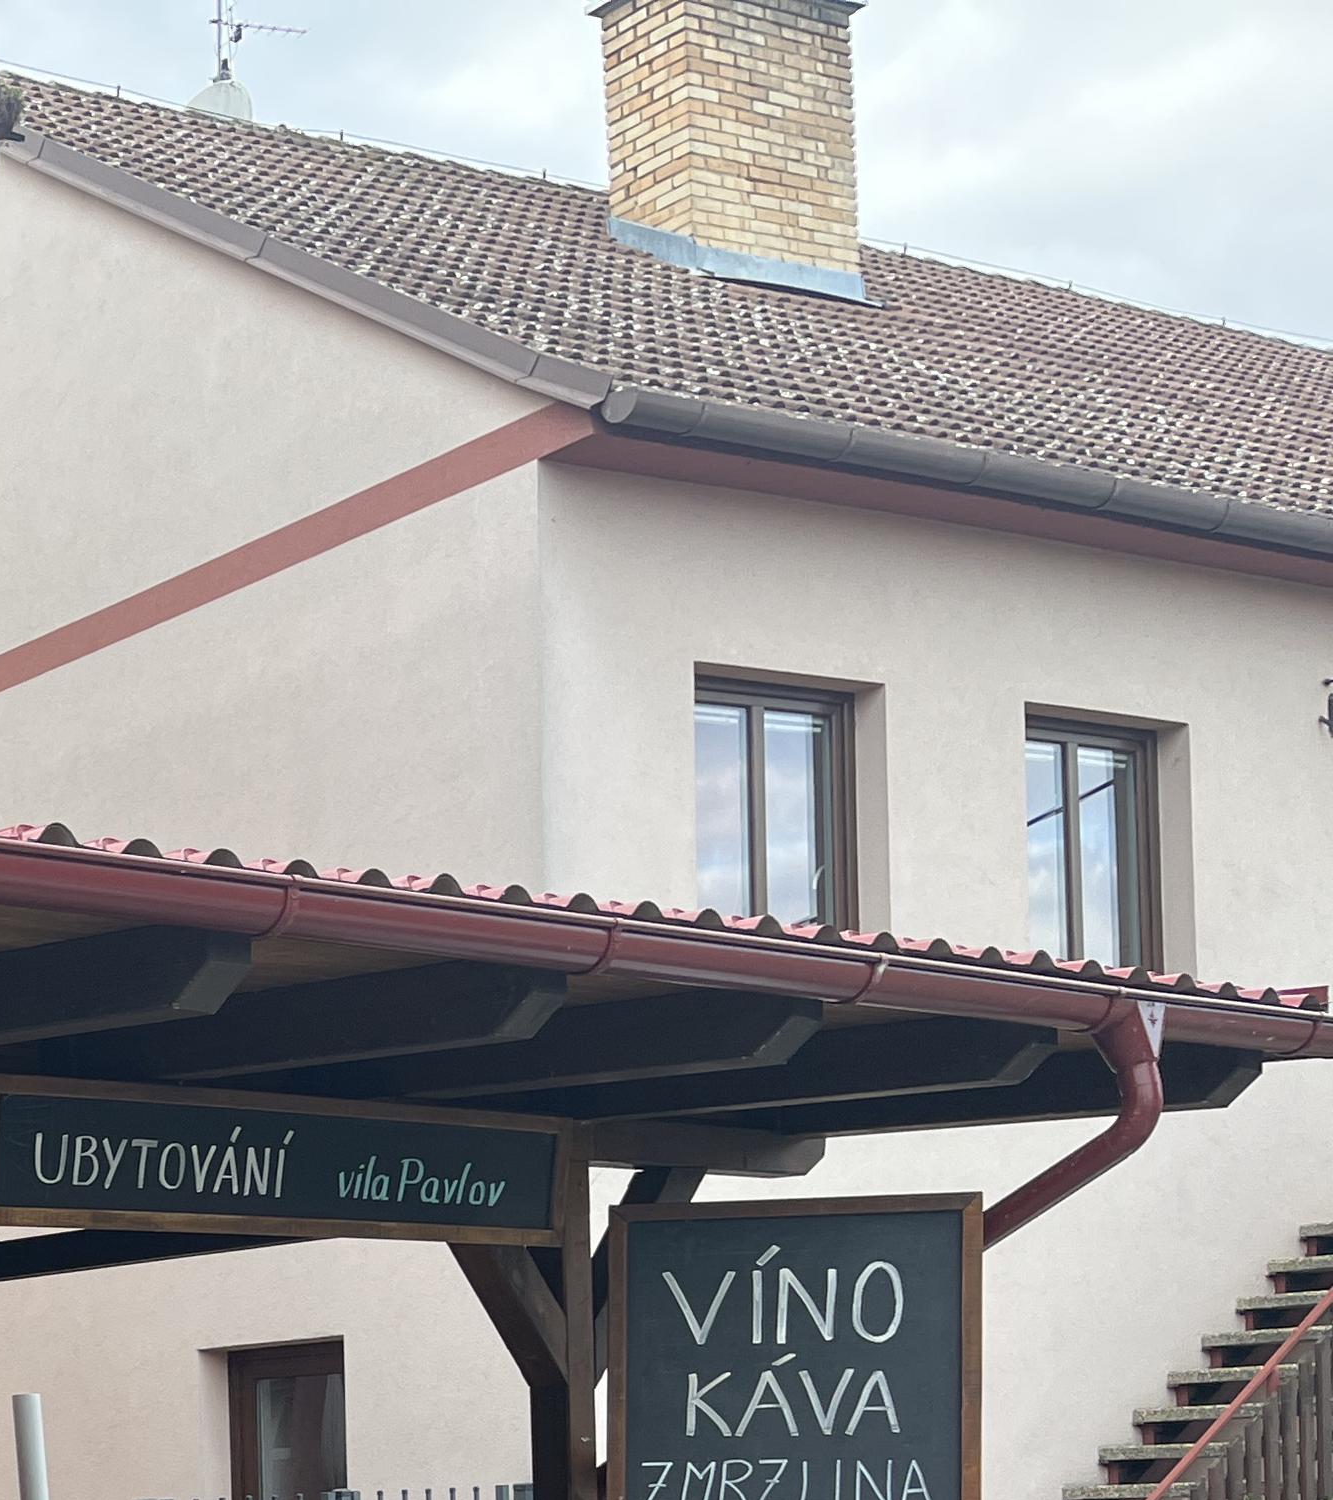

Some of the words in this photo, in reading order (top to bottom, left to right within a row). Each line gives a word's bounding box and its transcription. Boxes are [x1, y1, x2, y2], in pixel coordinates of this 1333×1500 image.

[34, 1125, 298, 1199] UBYTOVÁNÍ
[662, 1244, 905, 1345] VÍNO
[685, 1352, 902, 1438] KÁVA
